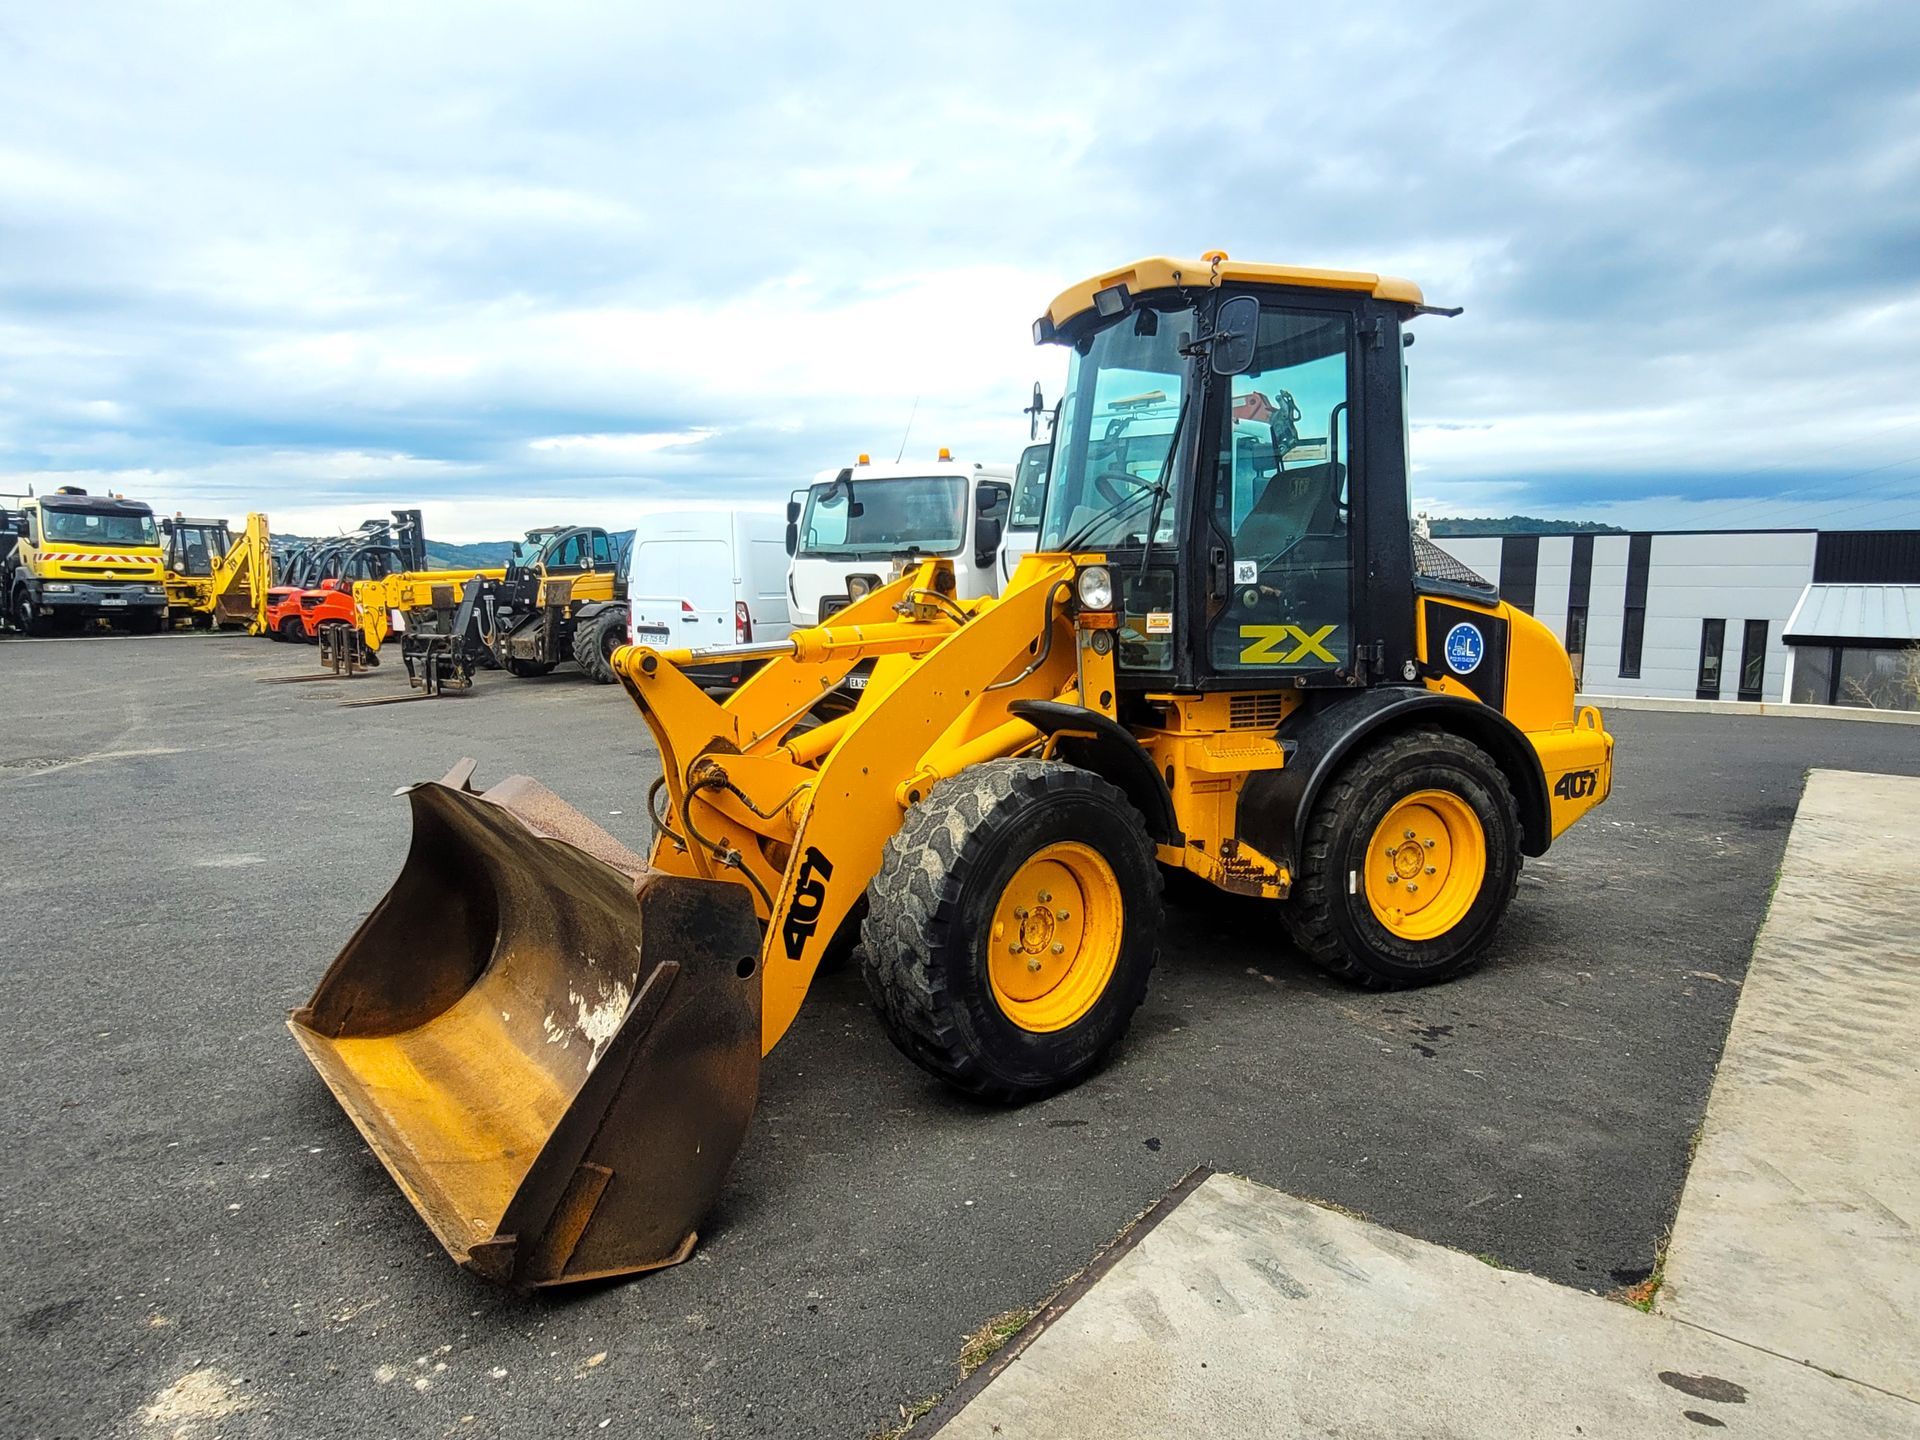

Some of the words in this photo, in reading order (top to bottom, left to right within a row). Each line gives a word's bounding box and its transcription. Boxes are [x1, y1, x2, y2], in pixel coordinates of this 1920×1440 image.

[1240, 624, 1341, 664] ZX
[1554, 769, 1599, 800] 407
[782, 846, 834, 961] 407
